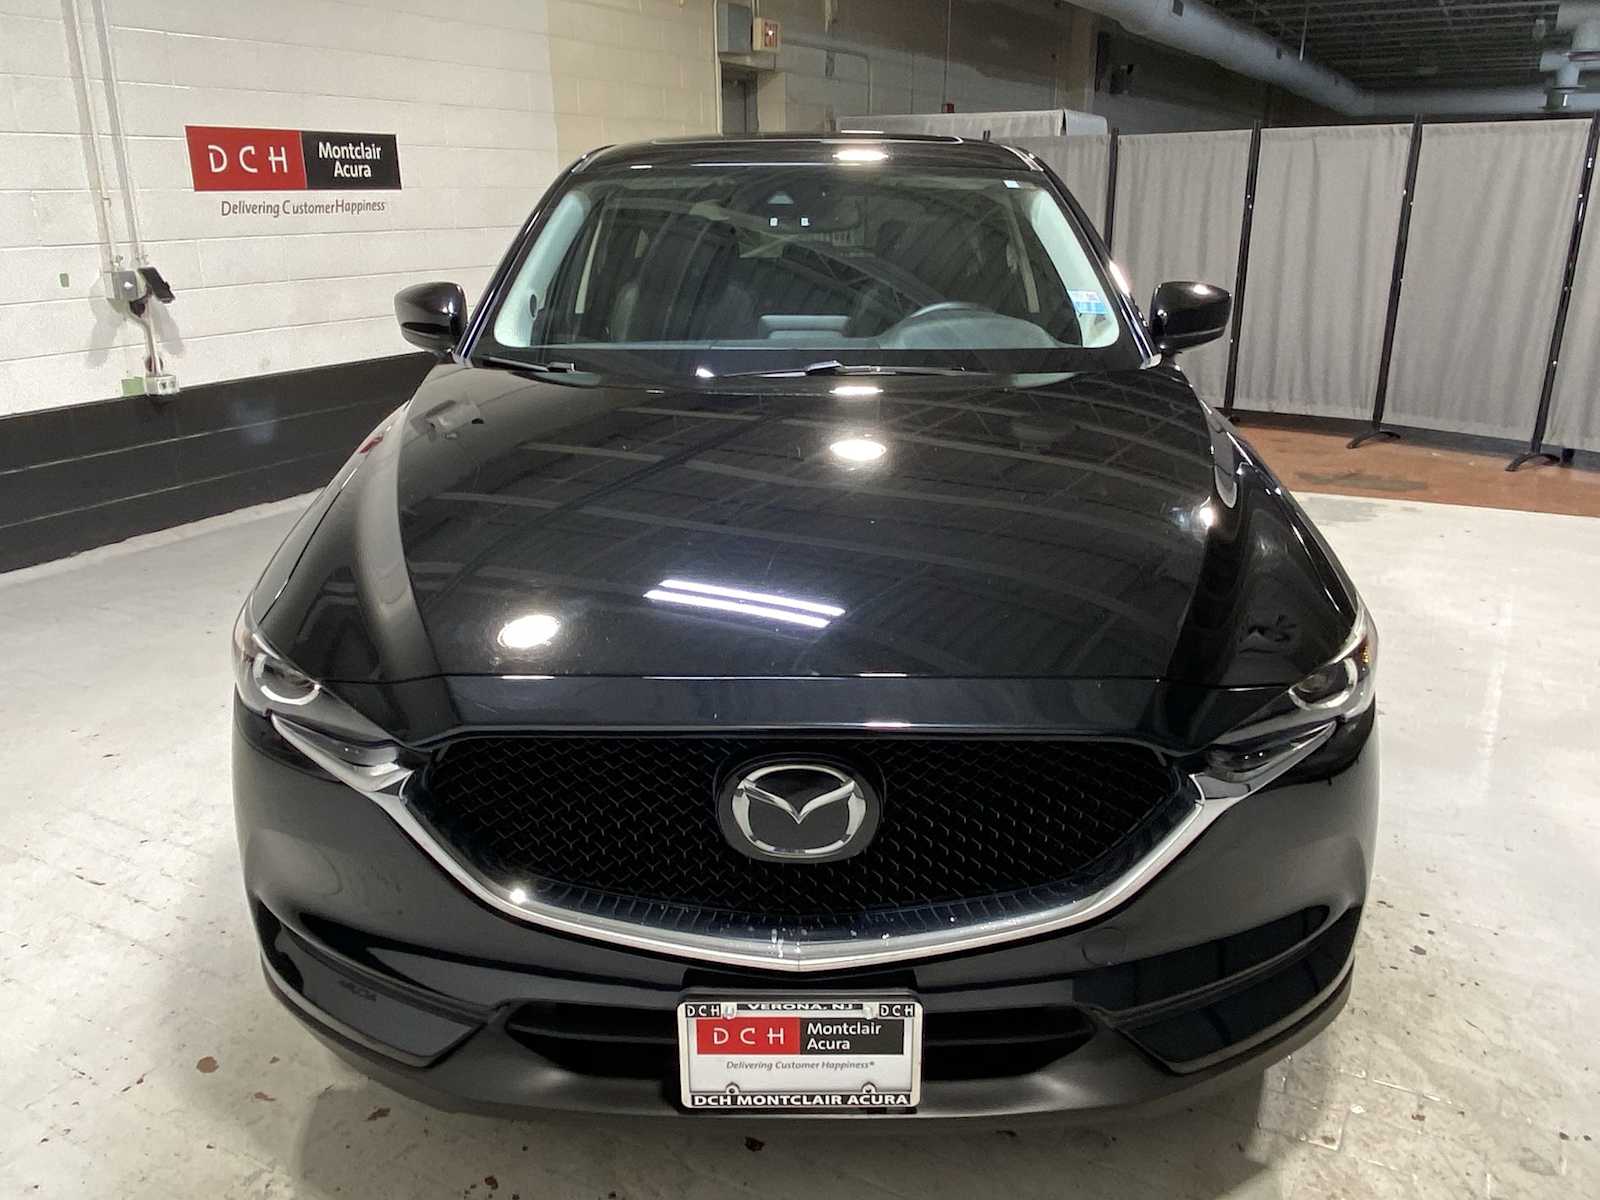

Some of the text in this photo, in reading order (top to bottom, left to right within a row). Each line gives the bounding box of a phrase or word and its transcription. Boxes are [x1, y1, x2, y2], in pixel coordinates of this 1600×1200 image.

[318, 141, 382, 160] Montclair
[207, 145, 288, 173] DCH
[334, 161, 372, 178] Acura
[221, 200, 280, 218] Delivering
[687, 1005, 720, 1017] DCH
[880, 1005, 914, 1017] DCH
[713, 1027, 785, 1045] DCH
[807, 1022, 882, 1036] Montclair
[807, 1038, 850, 1051] Acura
[726, 1060, 773, 1071] Delivering
[775, 1060, 820, 1070] Customer
[694, 1094, 909, 1106] DCH MONTCLAIR ACURA
